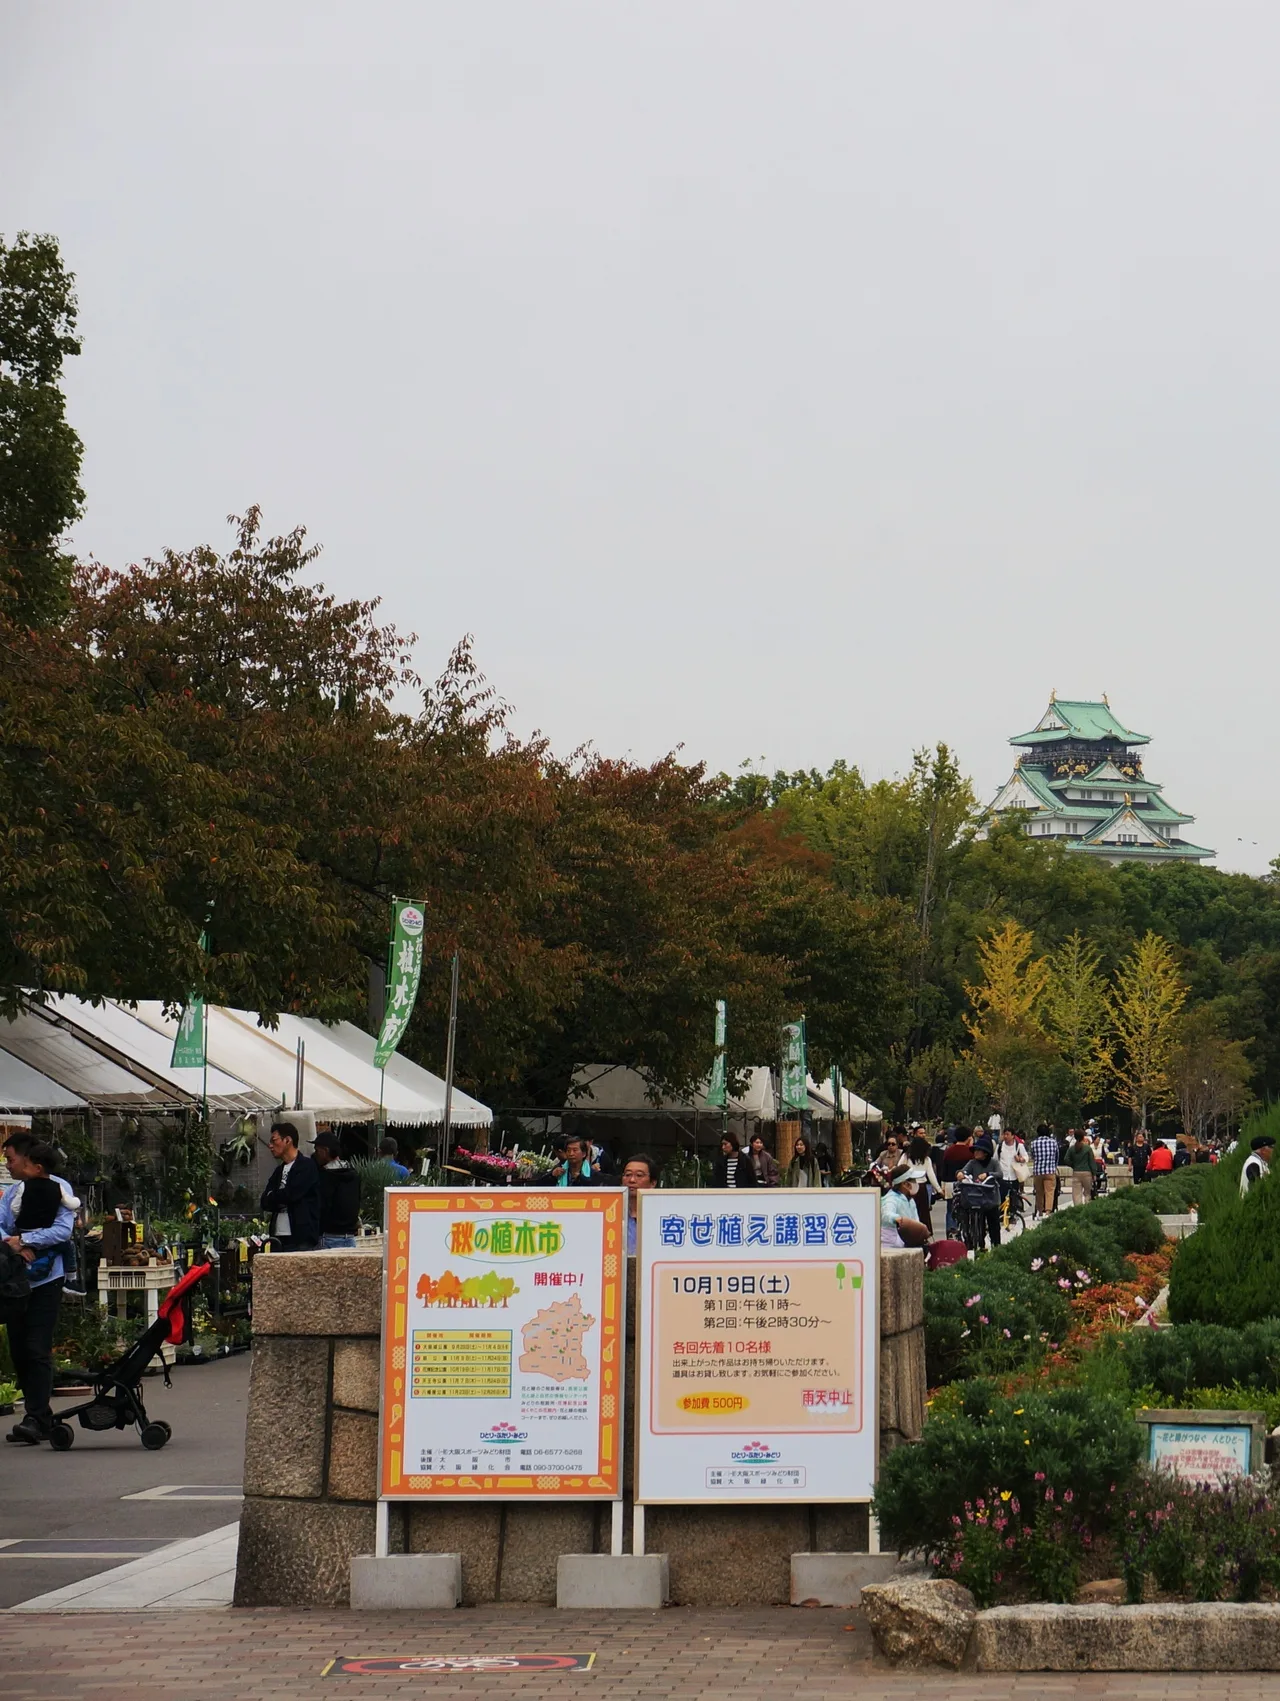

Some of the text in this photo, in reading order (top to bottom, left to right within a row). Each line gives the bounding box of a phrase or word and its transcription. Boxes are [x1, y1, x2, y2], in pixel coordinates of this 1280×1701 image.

[450, 1220, 563, 1256] 秋の植木市
[659, 1212, 859, 1248] 寄せ植え講習会
[672, 1275, 791, 1295] 10月19日(土)
[672, 1340, 772, 1355] 各回先着10名様
[682, 1397, 743, 1410] 参加費 500円
[801, 1388, 854, 1407] 雨天中止
